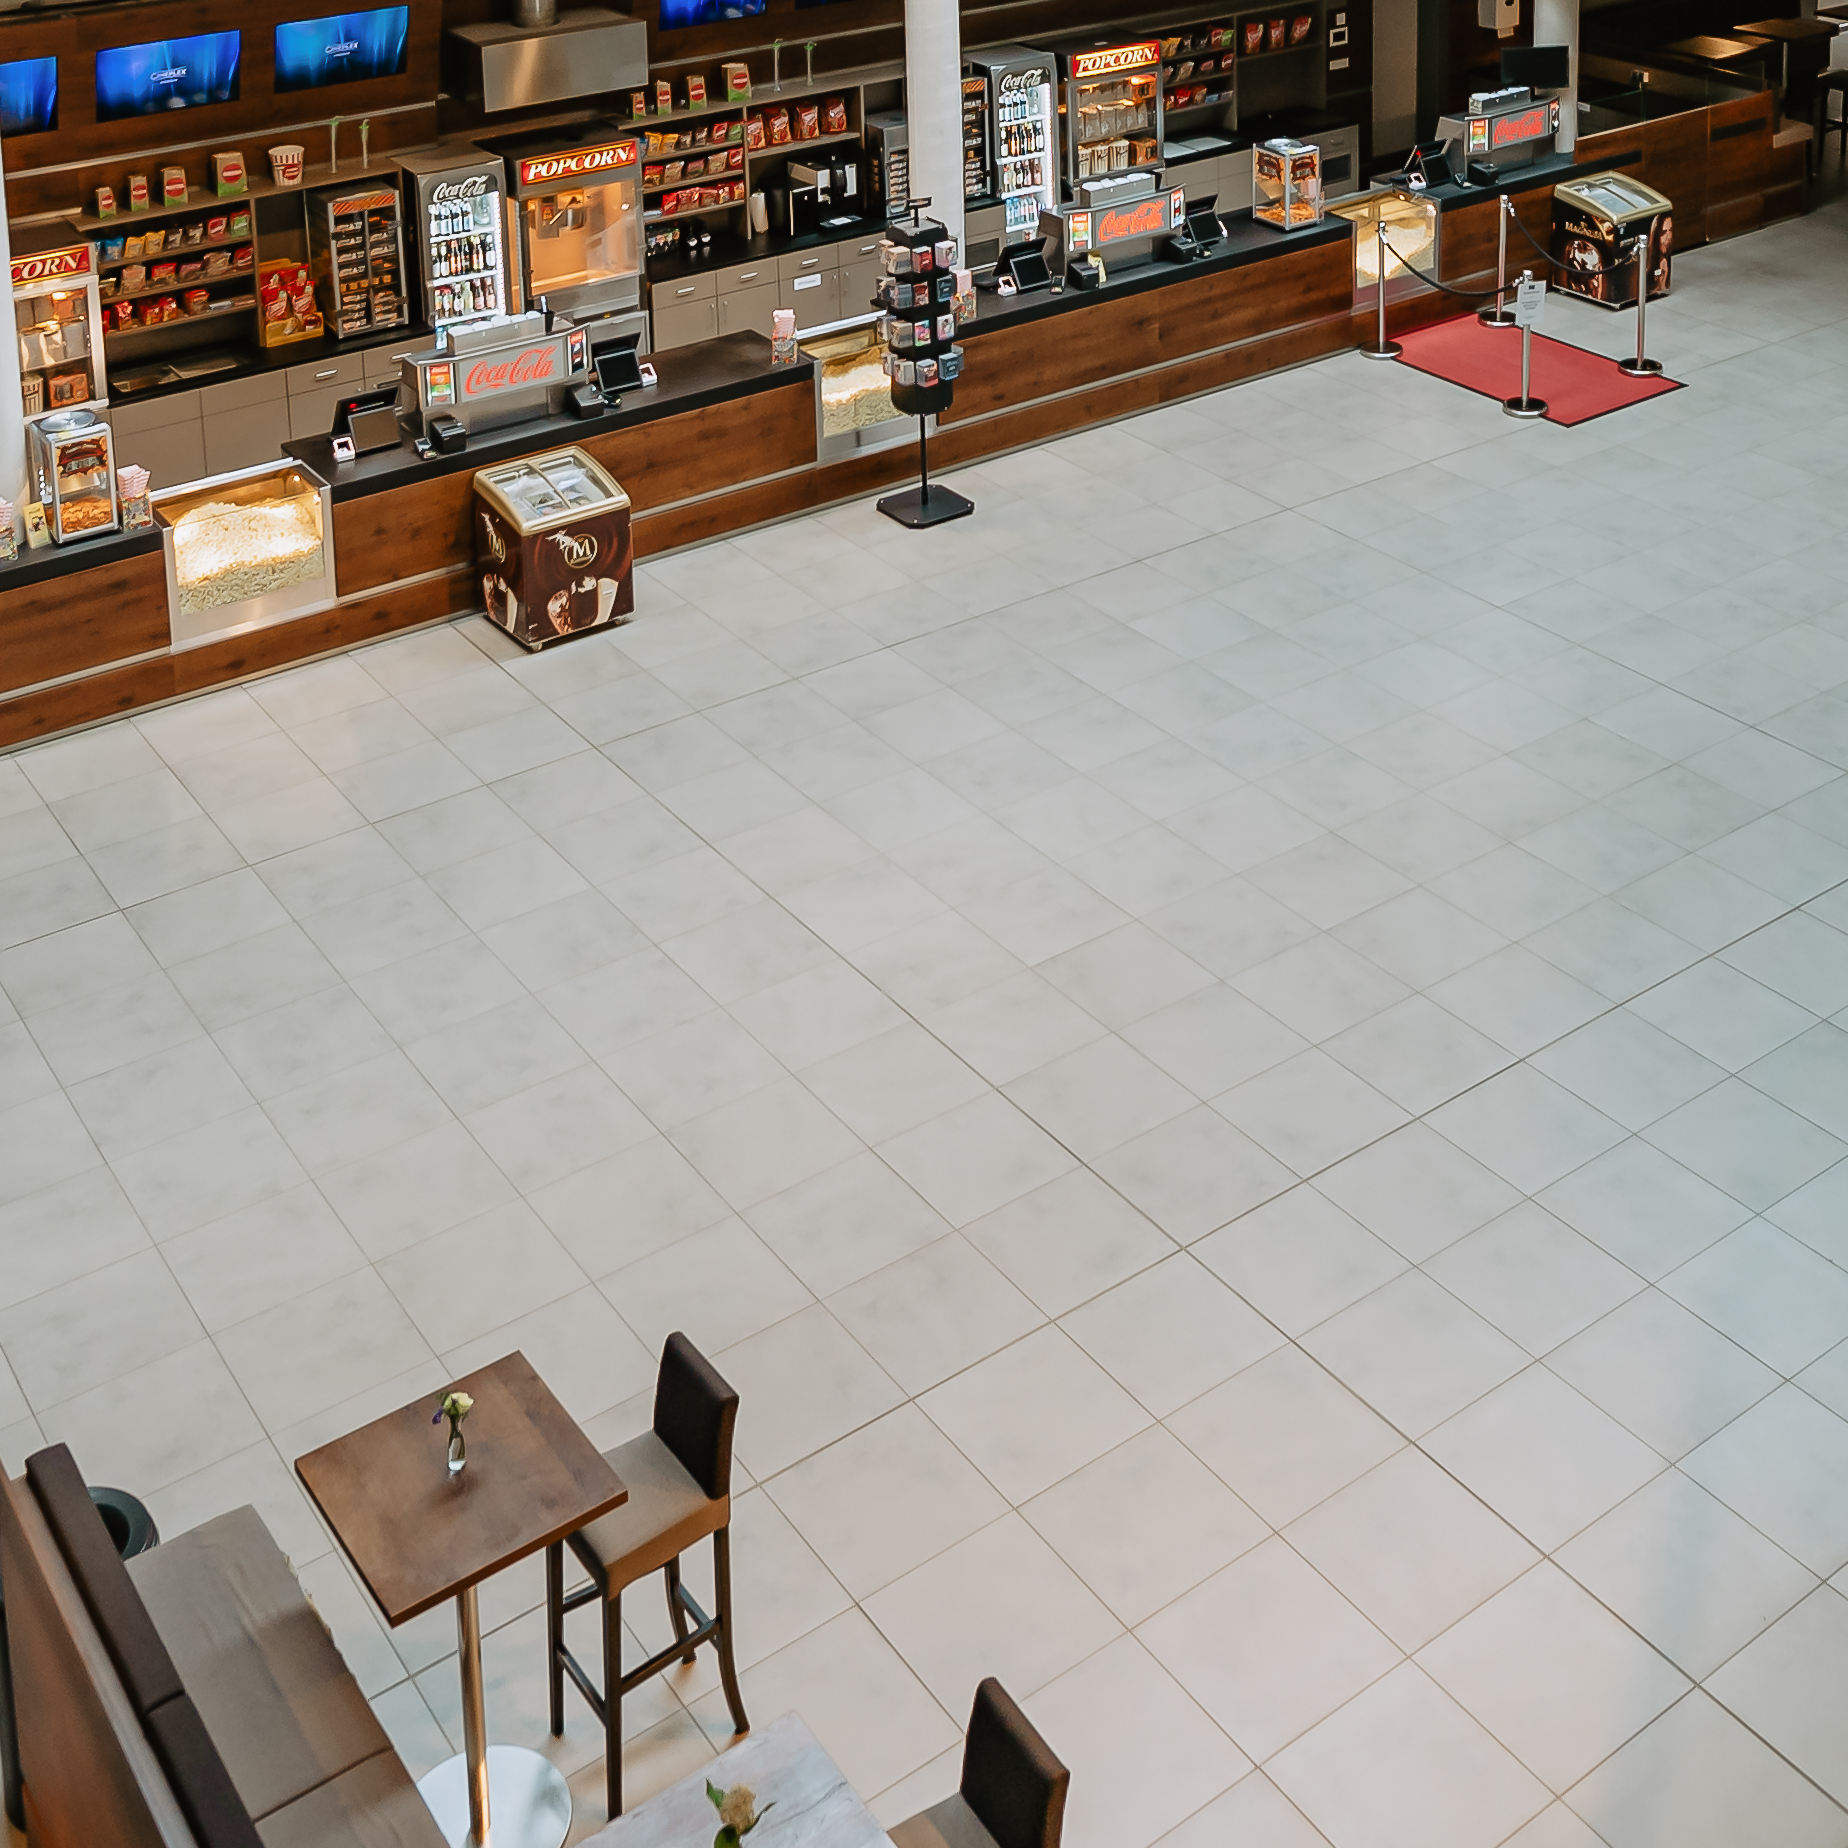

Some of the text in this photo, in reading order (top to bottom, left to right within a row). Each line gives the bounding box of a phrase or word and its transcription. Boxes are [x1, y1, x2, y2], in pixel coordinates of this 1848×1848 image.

[1078, 46, 1156, 73] POPCORN
[527, 146, 631, 181] POPCORN
[433, 174, 490, 203] Coca-Cola
[465, 345, 558, 395] Coca-Cola
